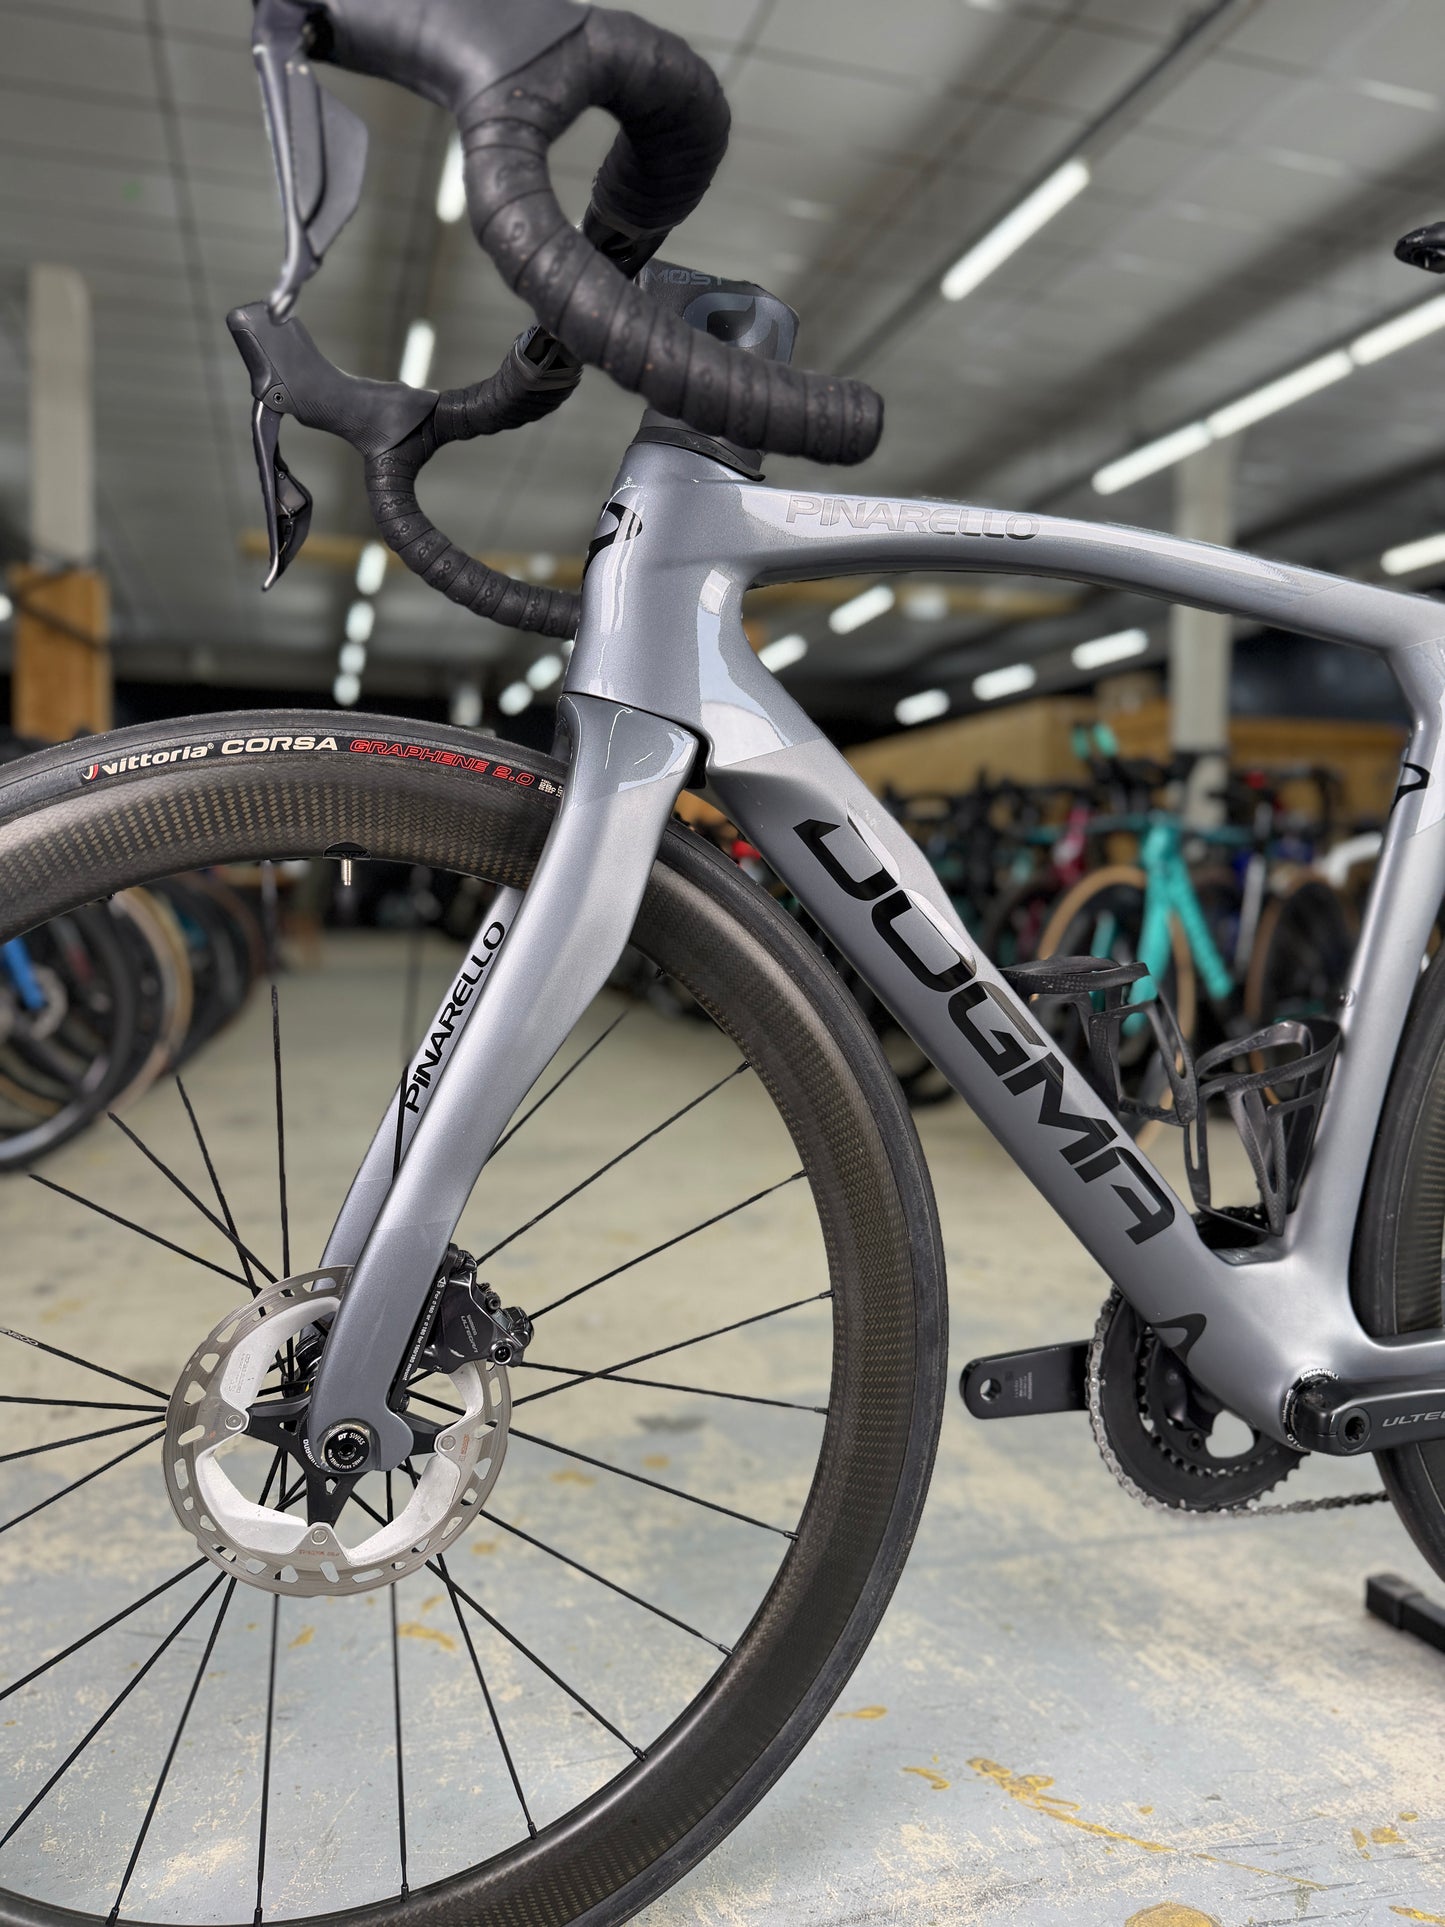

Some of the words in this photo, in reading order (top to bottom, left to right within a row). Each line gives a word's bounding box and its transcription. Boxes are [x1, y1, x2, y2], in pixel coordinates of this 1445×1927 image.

[786, 494, 1040, 540] PINARELLO
[221, 736, 338, 755] CORSA
[349, 739, 489, 773] GRAPHENE
[492, 765, 535, 786] 2.0
[405, 921, 506, 1114] PINARELLO
[792, 800, 1176, 1245] DOGMA
[337, 1432, 348, 1441] DT
[349, 1432, 366, 1446] SWISS
